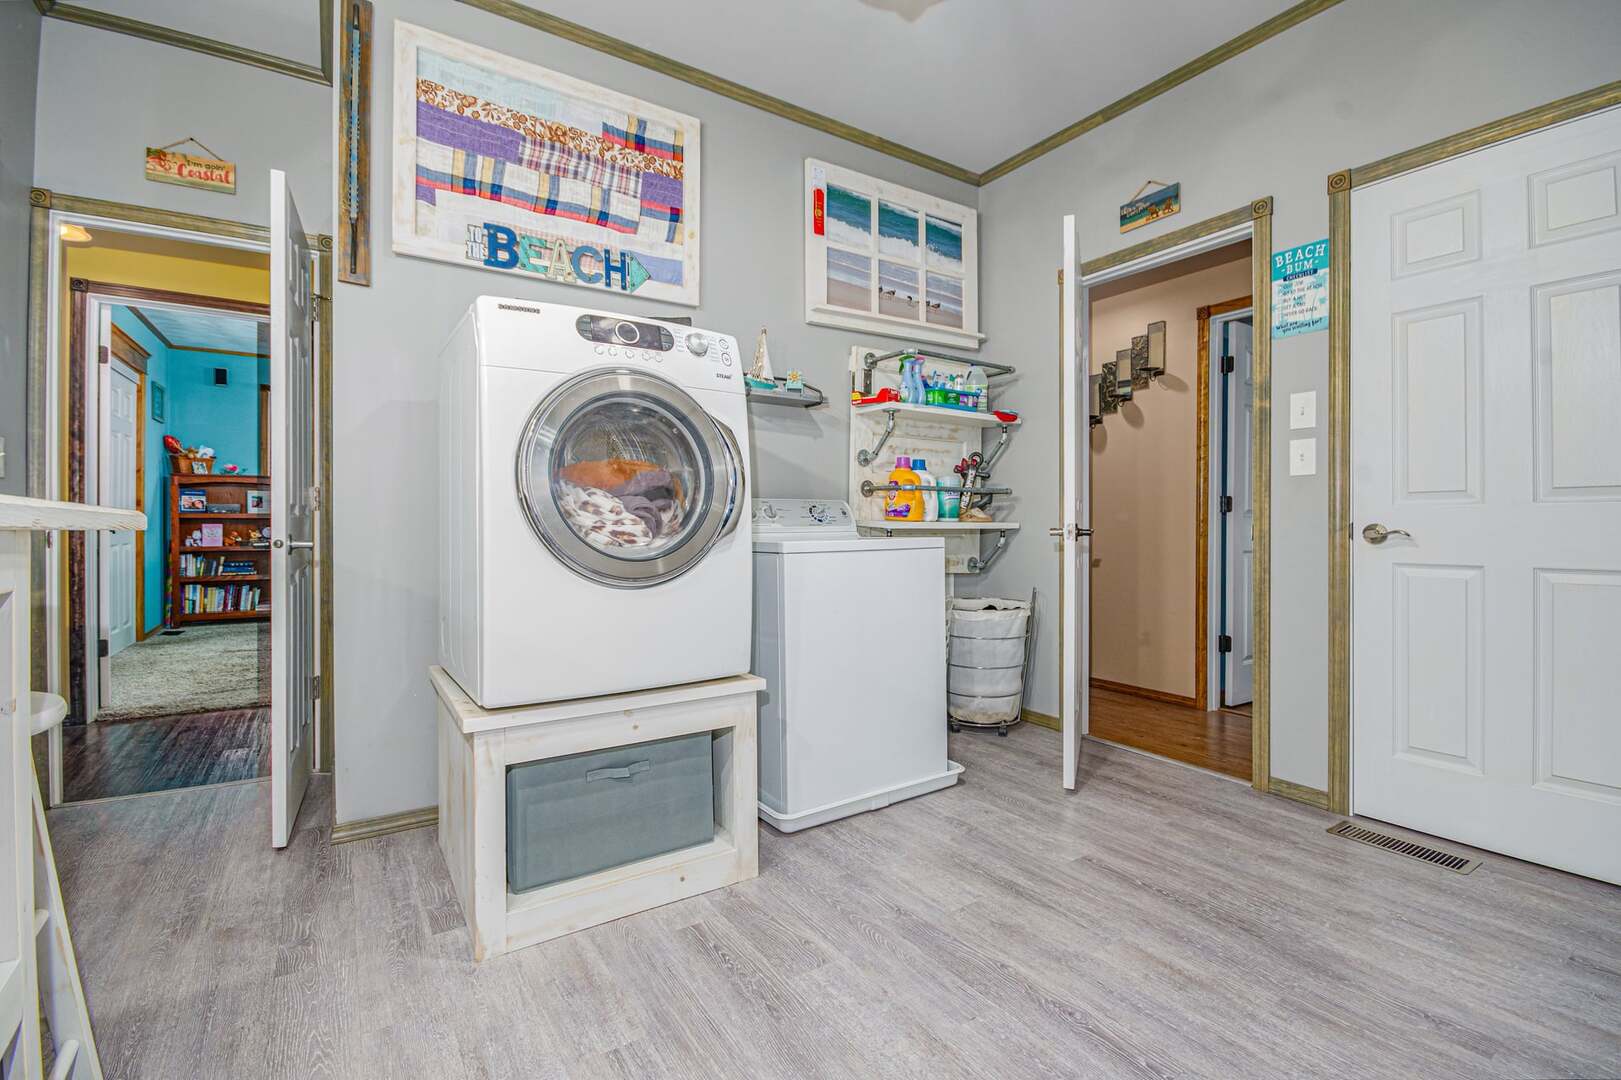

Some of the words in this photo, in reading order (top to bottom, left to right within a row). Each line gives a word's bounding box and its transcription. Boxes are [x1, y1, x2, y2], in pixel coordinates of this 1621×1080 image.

[177, 163, 231, 184] Coastal
[467, 223, 482, 242] TO
[465, 240, 488, 260] THE
[483, 222, 628, 291] BEACH
[1275, 244, 1325, 267] BEACH
